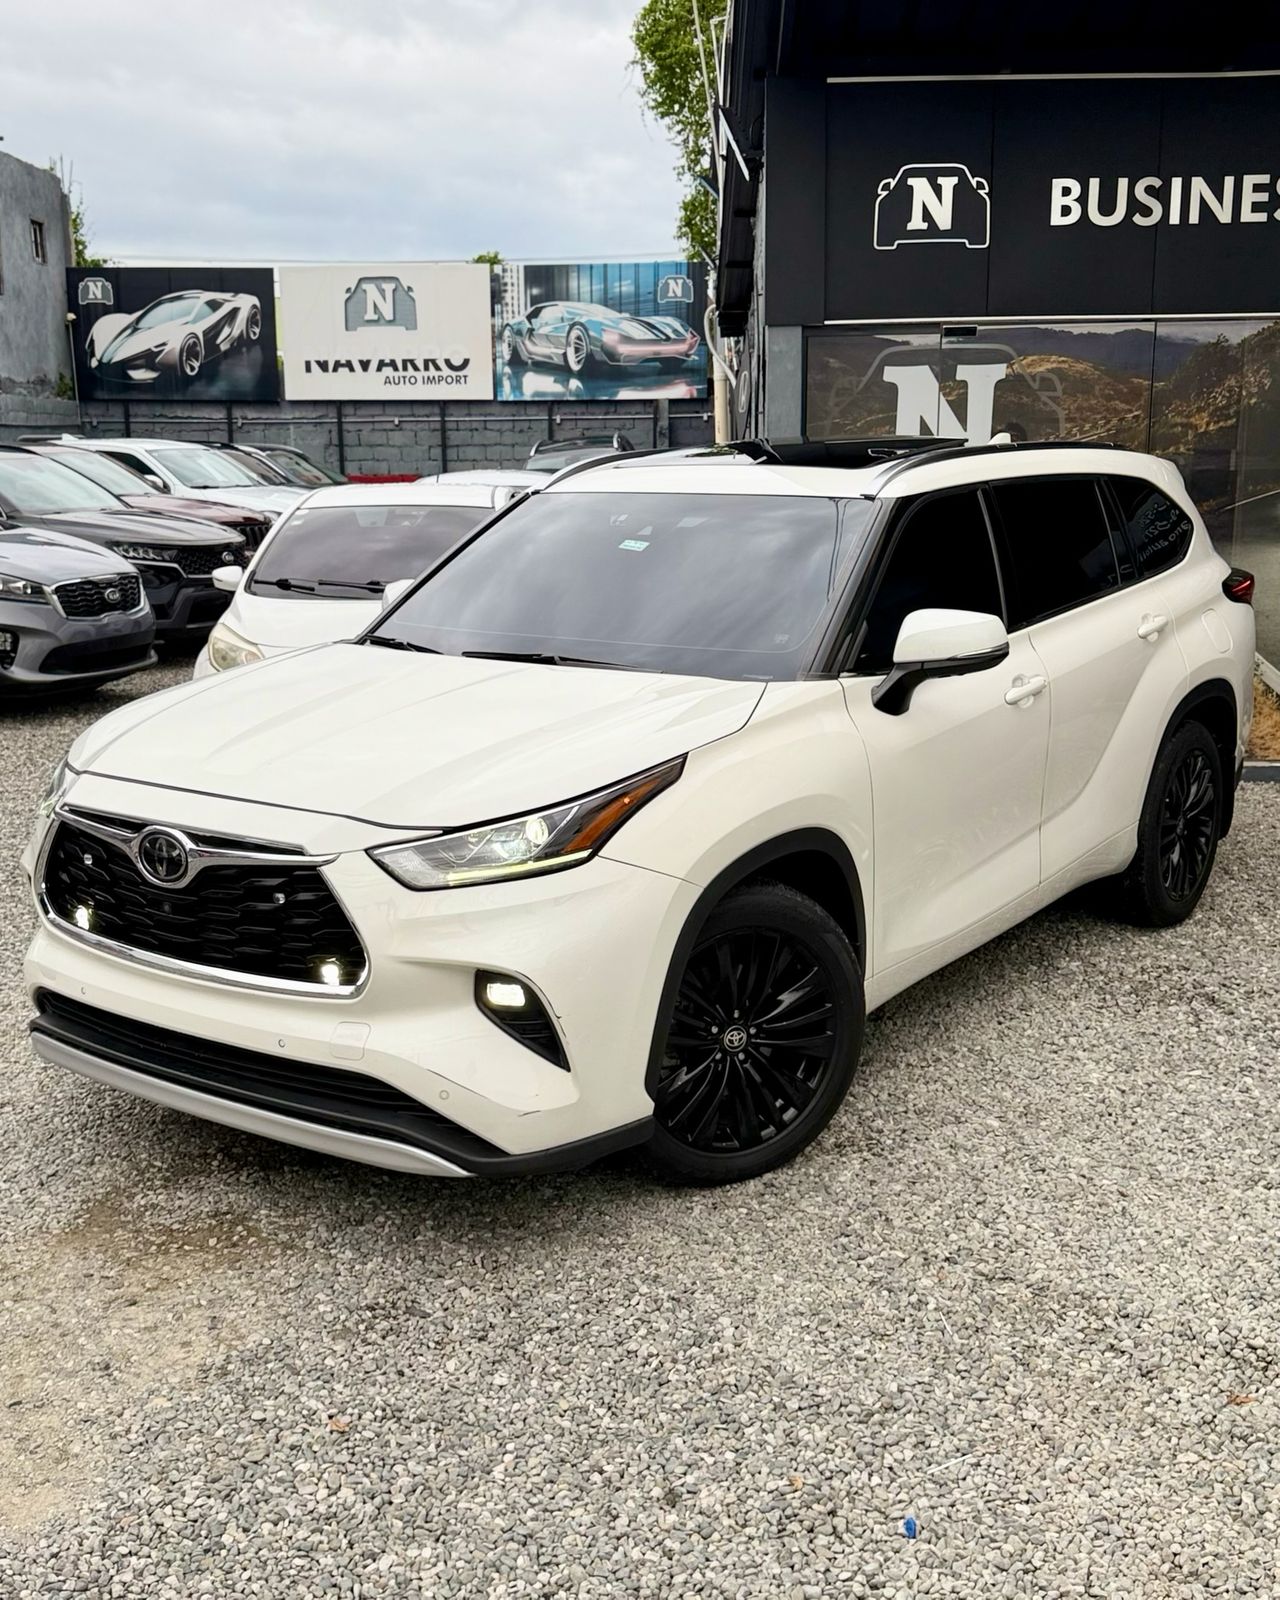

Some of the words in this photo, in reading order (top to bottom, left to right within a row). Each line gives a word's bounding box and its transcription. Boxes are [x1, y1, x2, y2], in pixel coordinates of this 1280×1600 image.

[906, 175, 959, 231] N
[1050, 173, 1280, 227] BUSINE
[87, 281, 103, 299] N
[667, 278, 684, 297] N
[361, 282, 396, 321] N
[383, 374, 418, 386] AUTO
[422, 374, 469, 386] IMPORT
